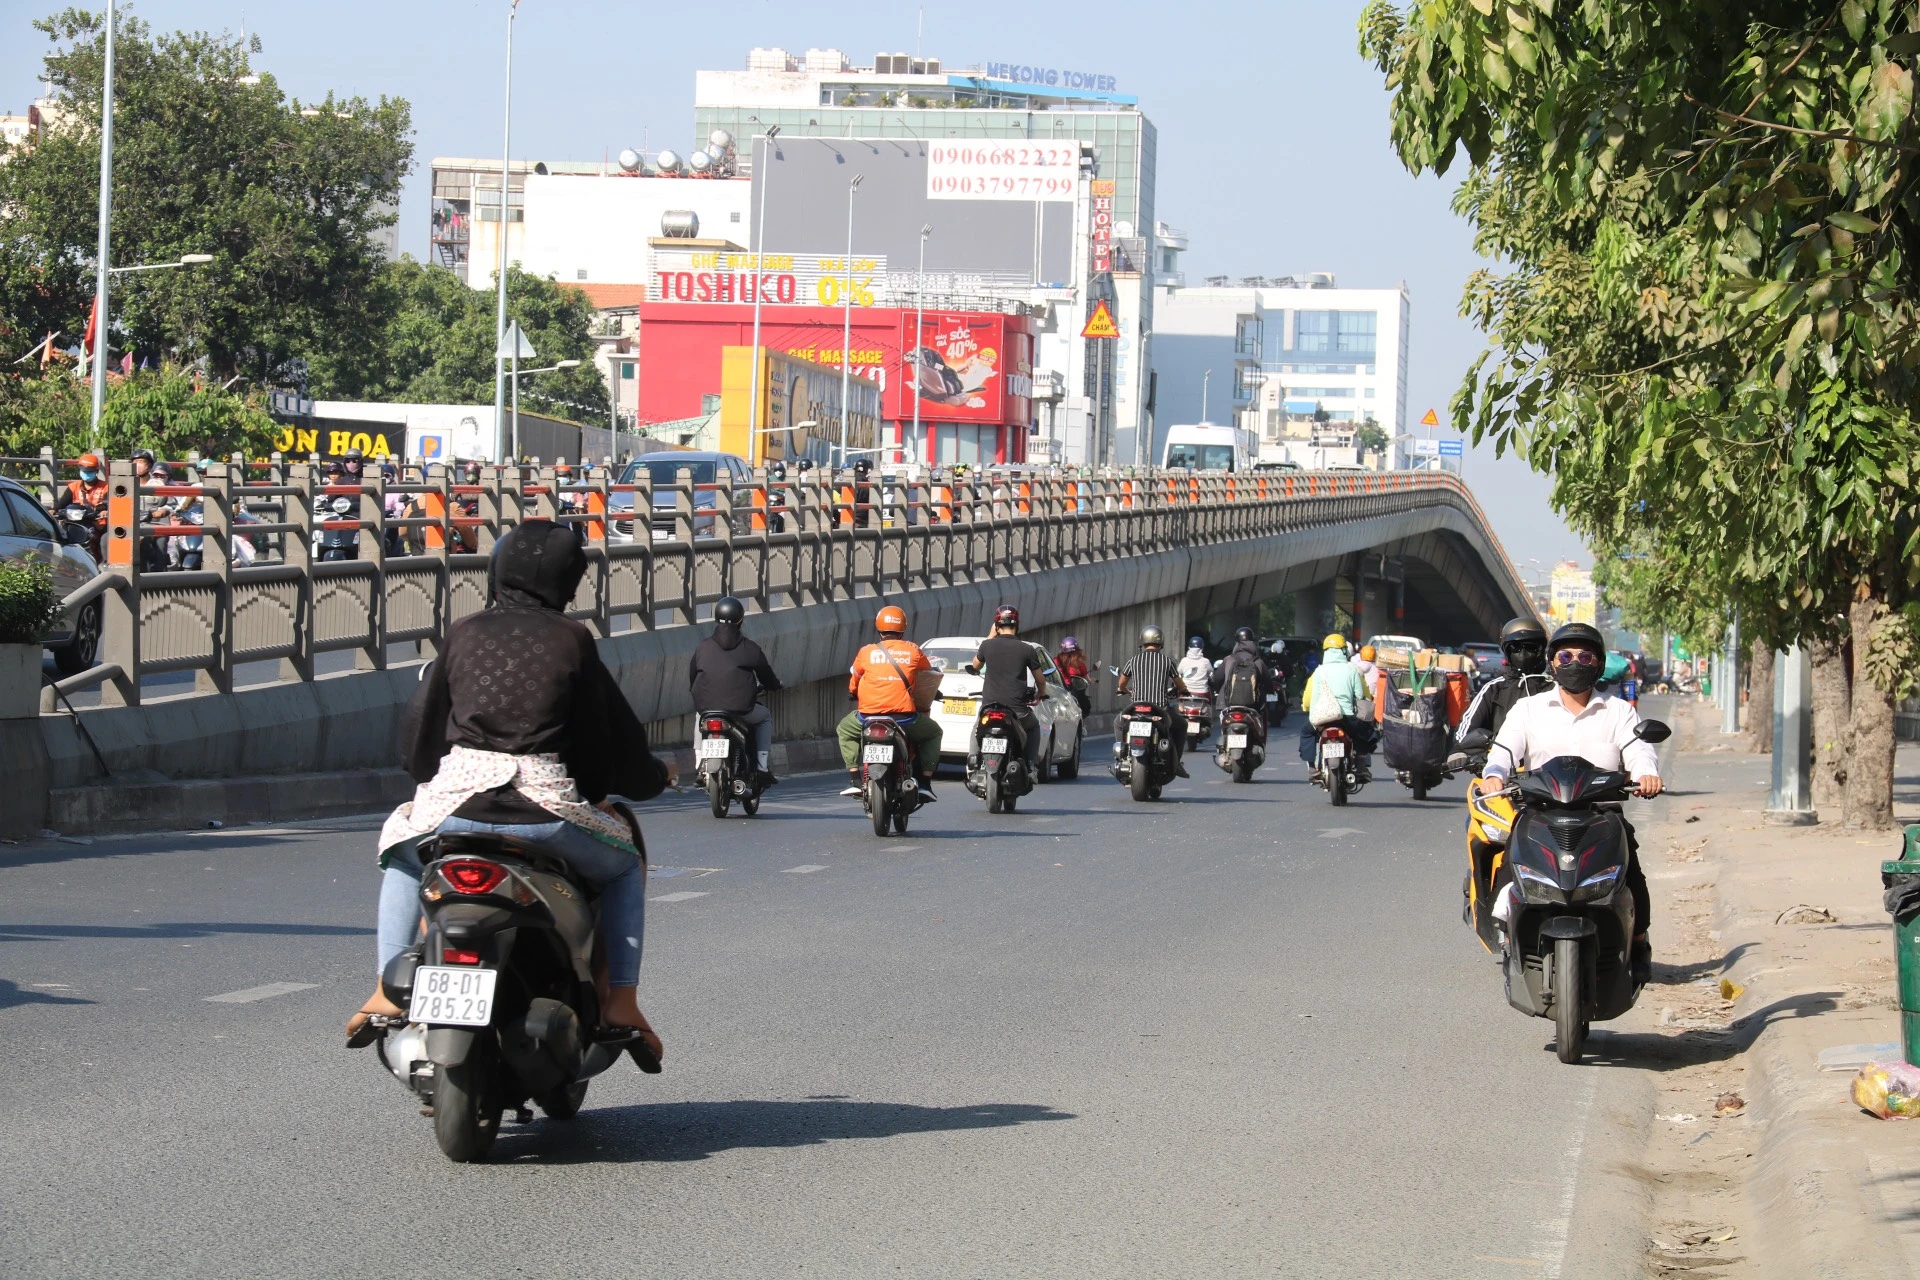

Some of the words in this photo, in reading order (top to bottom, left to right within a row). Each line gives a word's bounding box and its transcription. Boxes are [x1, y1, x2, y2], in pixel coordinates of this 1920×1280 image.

[986, 62, 1059, 86] MEKONG
[1063, 70, 1117, 92] TOWER
[932, 147, 1073, 167] 0906682222
[932, 176, 1073, 194] 0903797799
[1095, 198, 1111, 272] HOTEL
[656, 271, 797, 303] TOSHIKO
[817, 275, 875, 307] 0%
[946, 339, 978, 359] 40%
[328, 430, 392, 459] HOA
[428, 971, 482, 996] 68-D1
[416, 995, 488, 1021] 785.29
